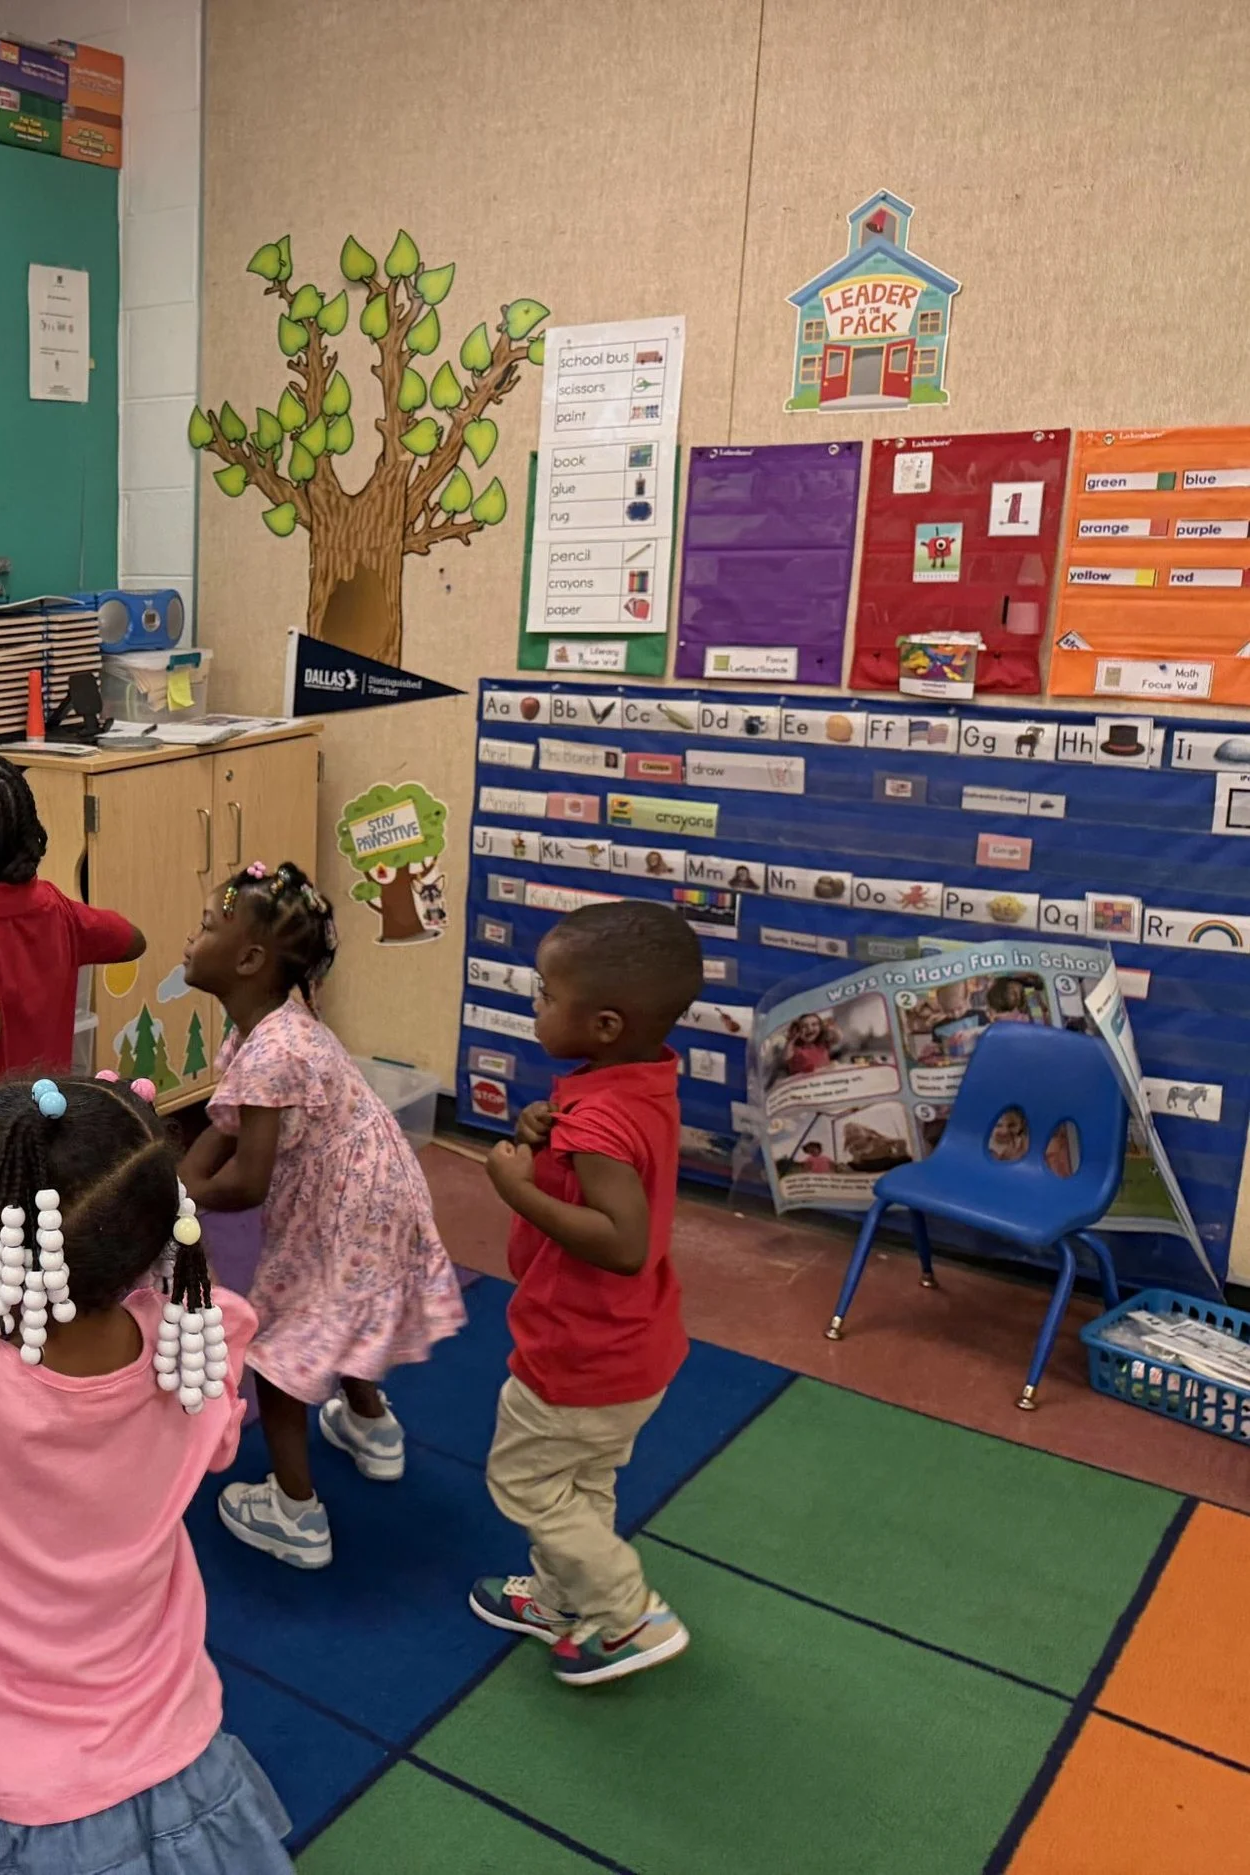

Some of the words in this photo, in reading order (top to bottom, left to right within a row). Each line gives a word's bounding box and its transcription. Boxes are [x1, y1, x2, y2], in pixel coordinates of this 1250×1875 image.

[824, 284, 918, 315] LEADER
[840, 312, 898, 335] PACK
[560, 352, 603, 368] school
[607, 351, 630, 363] bus
[558, 383, 606, 396] scissors
[556, 411, 586, 424] paint
[553, 455, 586, 468] book
[1087, 477, 1127, 489] green
[1185, 474, 1217, 485] blue
[551, 482, 576, 497] glue
[550, 511, 570, 522] rug
[1080, 523, 1129, 535] orange
[1176, 525, 1222, 537] purple
[550, 550, 591, 564] pencil
[1069, 571, 1111, 582] yellow
[1171, 572, 1194, 582] red
[548, 579, 594, 590] crayons
[546, 604, 581, 616] paper
[304, 668, 346, 687] DALLAS
[1175, 669, 1199, 678] Math
[368, 676, 423, 689] Distinguished
[1142, 680, 1172, 690] Focus
[1176, 680, 1198, 690] Wall
[367, 685, 400, 697] Teacher
[486, 700, 510, 714] Aa
[554, 701, 577, 719] Bb
[625, 704, 651, 723] Cc
[701, 709, 729, 729] Dd
[783, 714, 808, 735] Ee
[870, 720, 895, 741] Ff
[964, 726, 996, 754] Gg
[1063, 731, 1092, 755] Hh
[1176, 738, 1193, 761] Ii
[692, 764, 725, 777] draw
[367, 813, 395, 833] STAY
[655, 812, 714, 832] crayons
[356, 821, 419, 852] PAWSITIVE
[475, 831, 493, 852] Jj
[542, 843, 564, 860] Kk
[688, 860, 723, 881] Mm
[770, 870, 796, 891] Nn
[856, 882, 886, 904] Oo
[946, 892, 974, 917] Pp
[1044, 904, 1078, 931] Qq
[1148, 915, 1174, 938] Rr
[828, 977, 877, 1001] Ways
[885, 972, 906, 984] to
[914, 960, 964, 983] Have
[970, 953, 1006, 970] Fun
[1040, 951, 1106, 973] School
